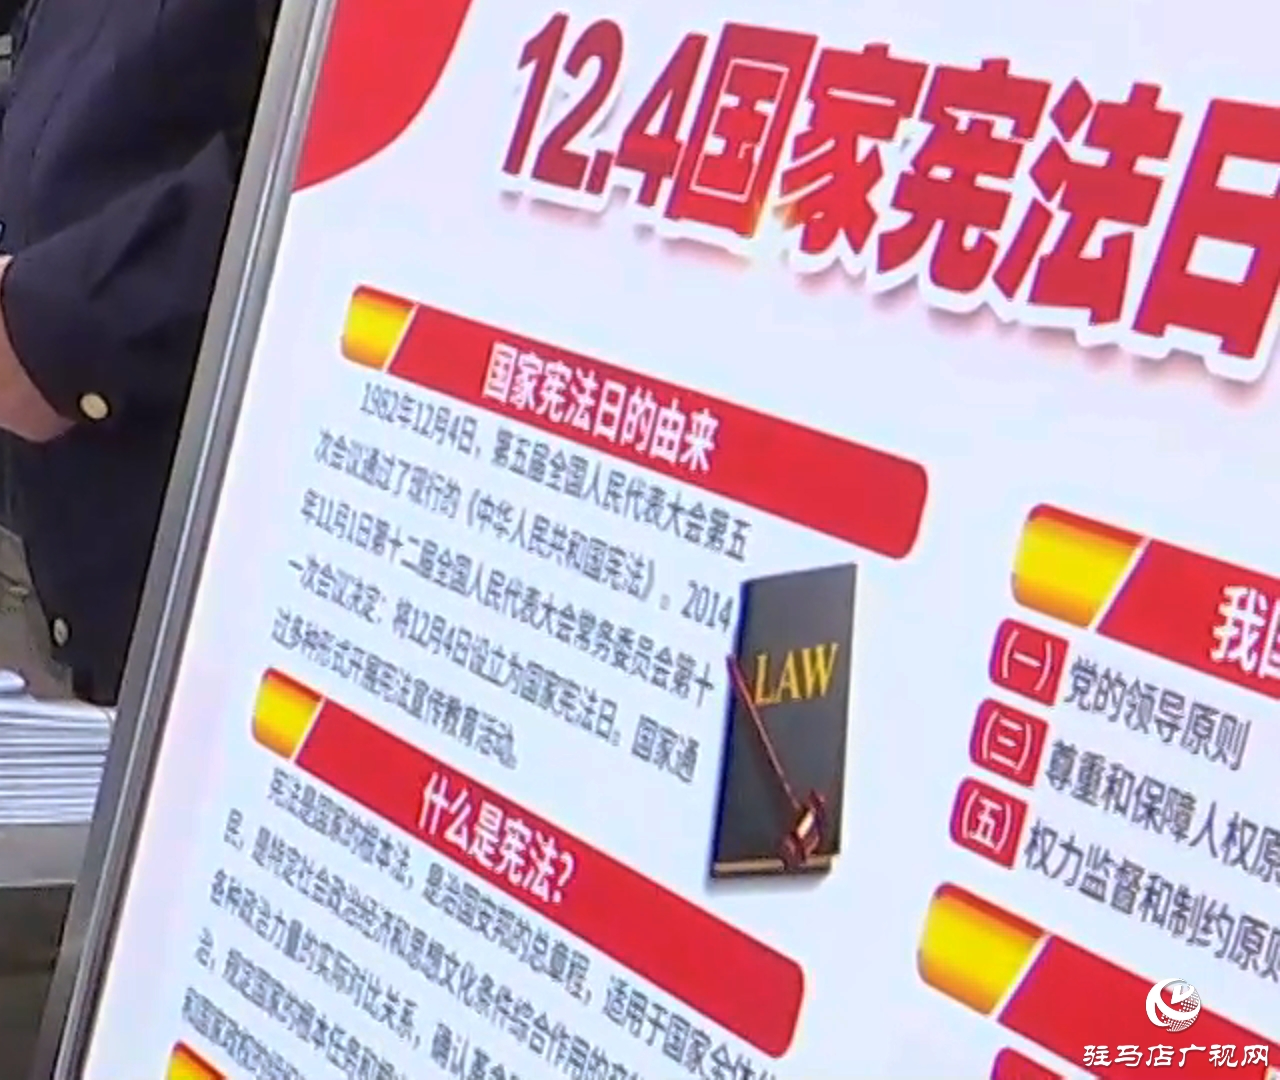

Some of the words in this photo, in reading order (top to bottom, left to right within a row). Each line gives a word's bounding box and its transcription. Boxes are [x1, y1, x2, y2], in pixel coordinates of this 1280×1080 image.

[501, 12, 1280, 360] 12.4国家宪法日
[482, 340, 719, 473] 国家宪法日的由来
[753, 642, 839, 706] LAW
[1064, 655, 1253, 772] 党的领导原则
[419, 771, 576, 905] 什么是宪法?
